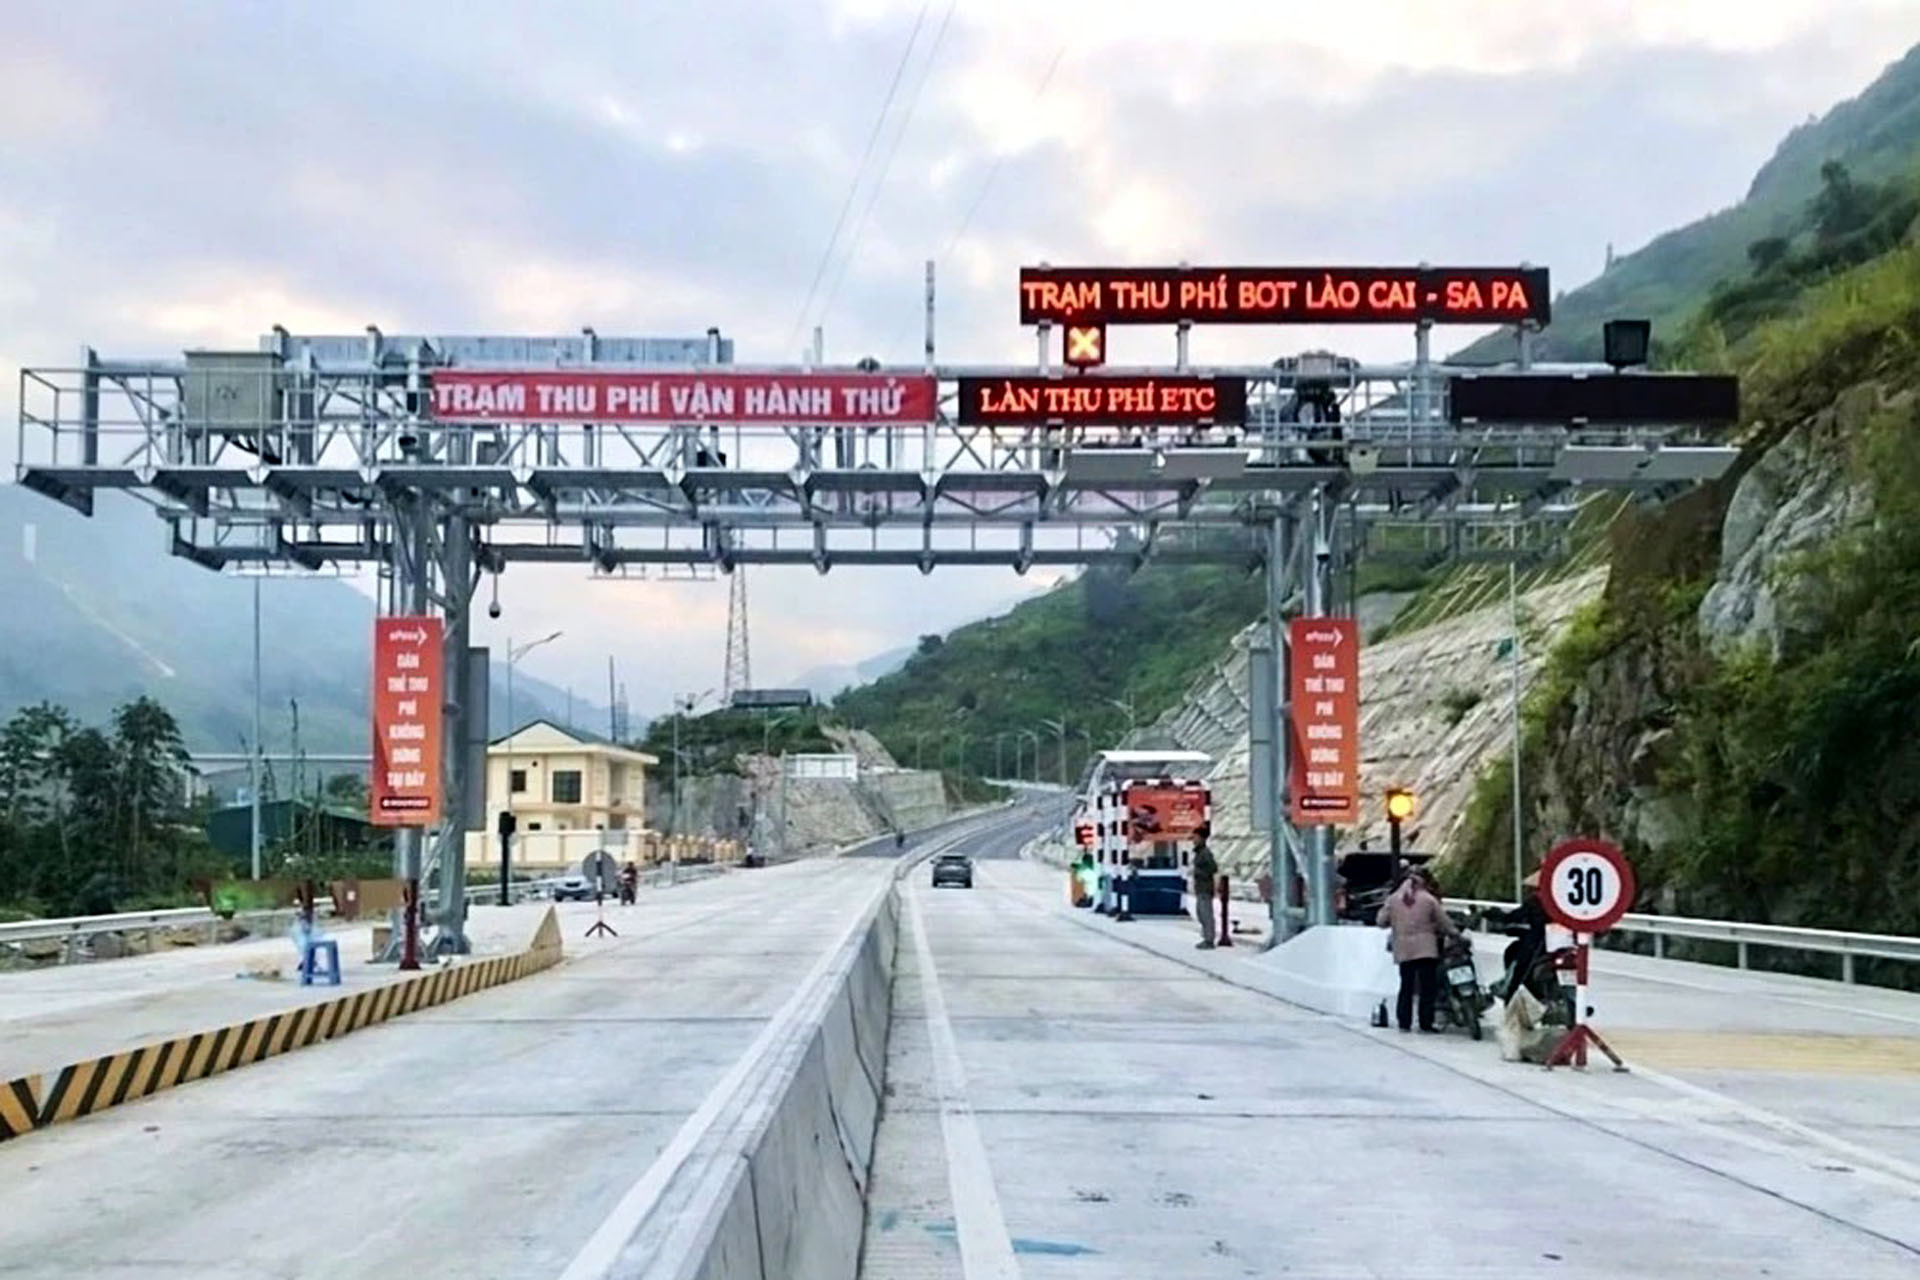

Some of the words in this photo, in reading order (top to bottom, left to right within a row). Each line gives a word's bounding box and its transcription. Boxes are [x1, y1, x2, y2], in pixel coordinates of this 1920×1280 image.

[1022, 280, 1101, 315] TRẠM
[1110, 280, 1170, 309] THU
[1180, 273, 1227, 309] PHÍ
[1238, 280, 1297, 309] BOT
[1305, 273, 1361, 310] LÀO
[1367, 280, 1417, 310] CAI
[1446, 280, 1484, 310] SA
[1491, 280, 1529, 310] PA
[434, 383, 526, 416] TRẠM
[536, 384, 597, 413] THU
[606, 380, 661, 414] PHÍ
[669, 380, 735, 420] VẬN
[744, 381, 832, 415] HÀNH
[841, 378, 906, 415] THỬ
[980, 380, 1040, 413] LÀN
[1044, 387, 1102, 413] THU
[1107, 380, 1155, 413] PHÍ
[1160, 387, 1216, 413] ETC
[1568, 867, 1602, 906] 30
